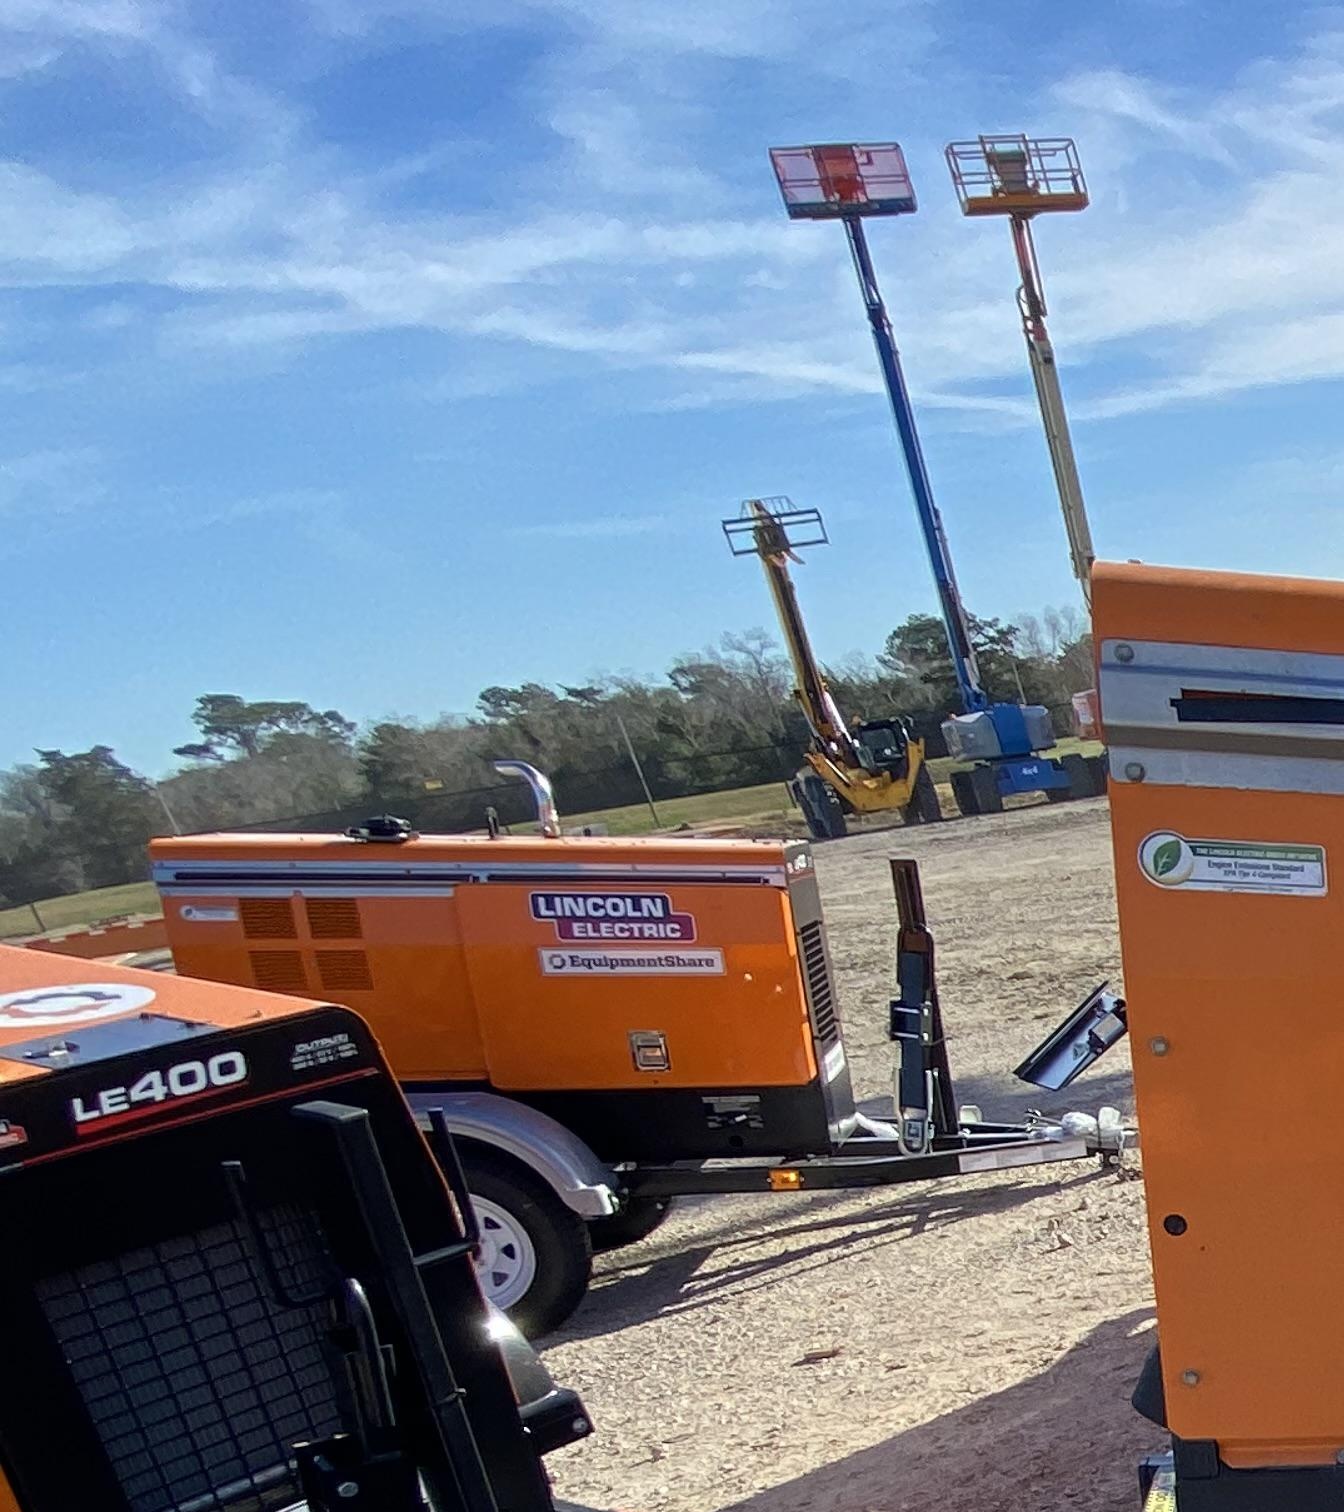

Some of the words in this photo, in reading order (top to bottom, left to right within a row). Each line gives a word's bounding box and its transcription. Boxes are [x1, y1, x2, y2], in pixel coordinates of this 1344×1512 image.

[537, 896, 665, 918] LINCOLN
[572, 922, 682, 938] ELECTRIC
[568, 954, 715, 971] EquipmentShare
[72, 1051, 247, 1123] LE400
